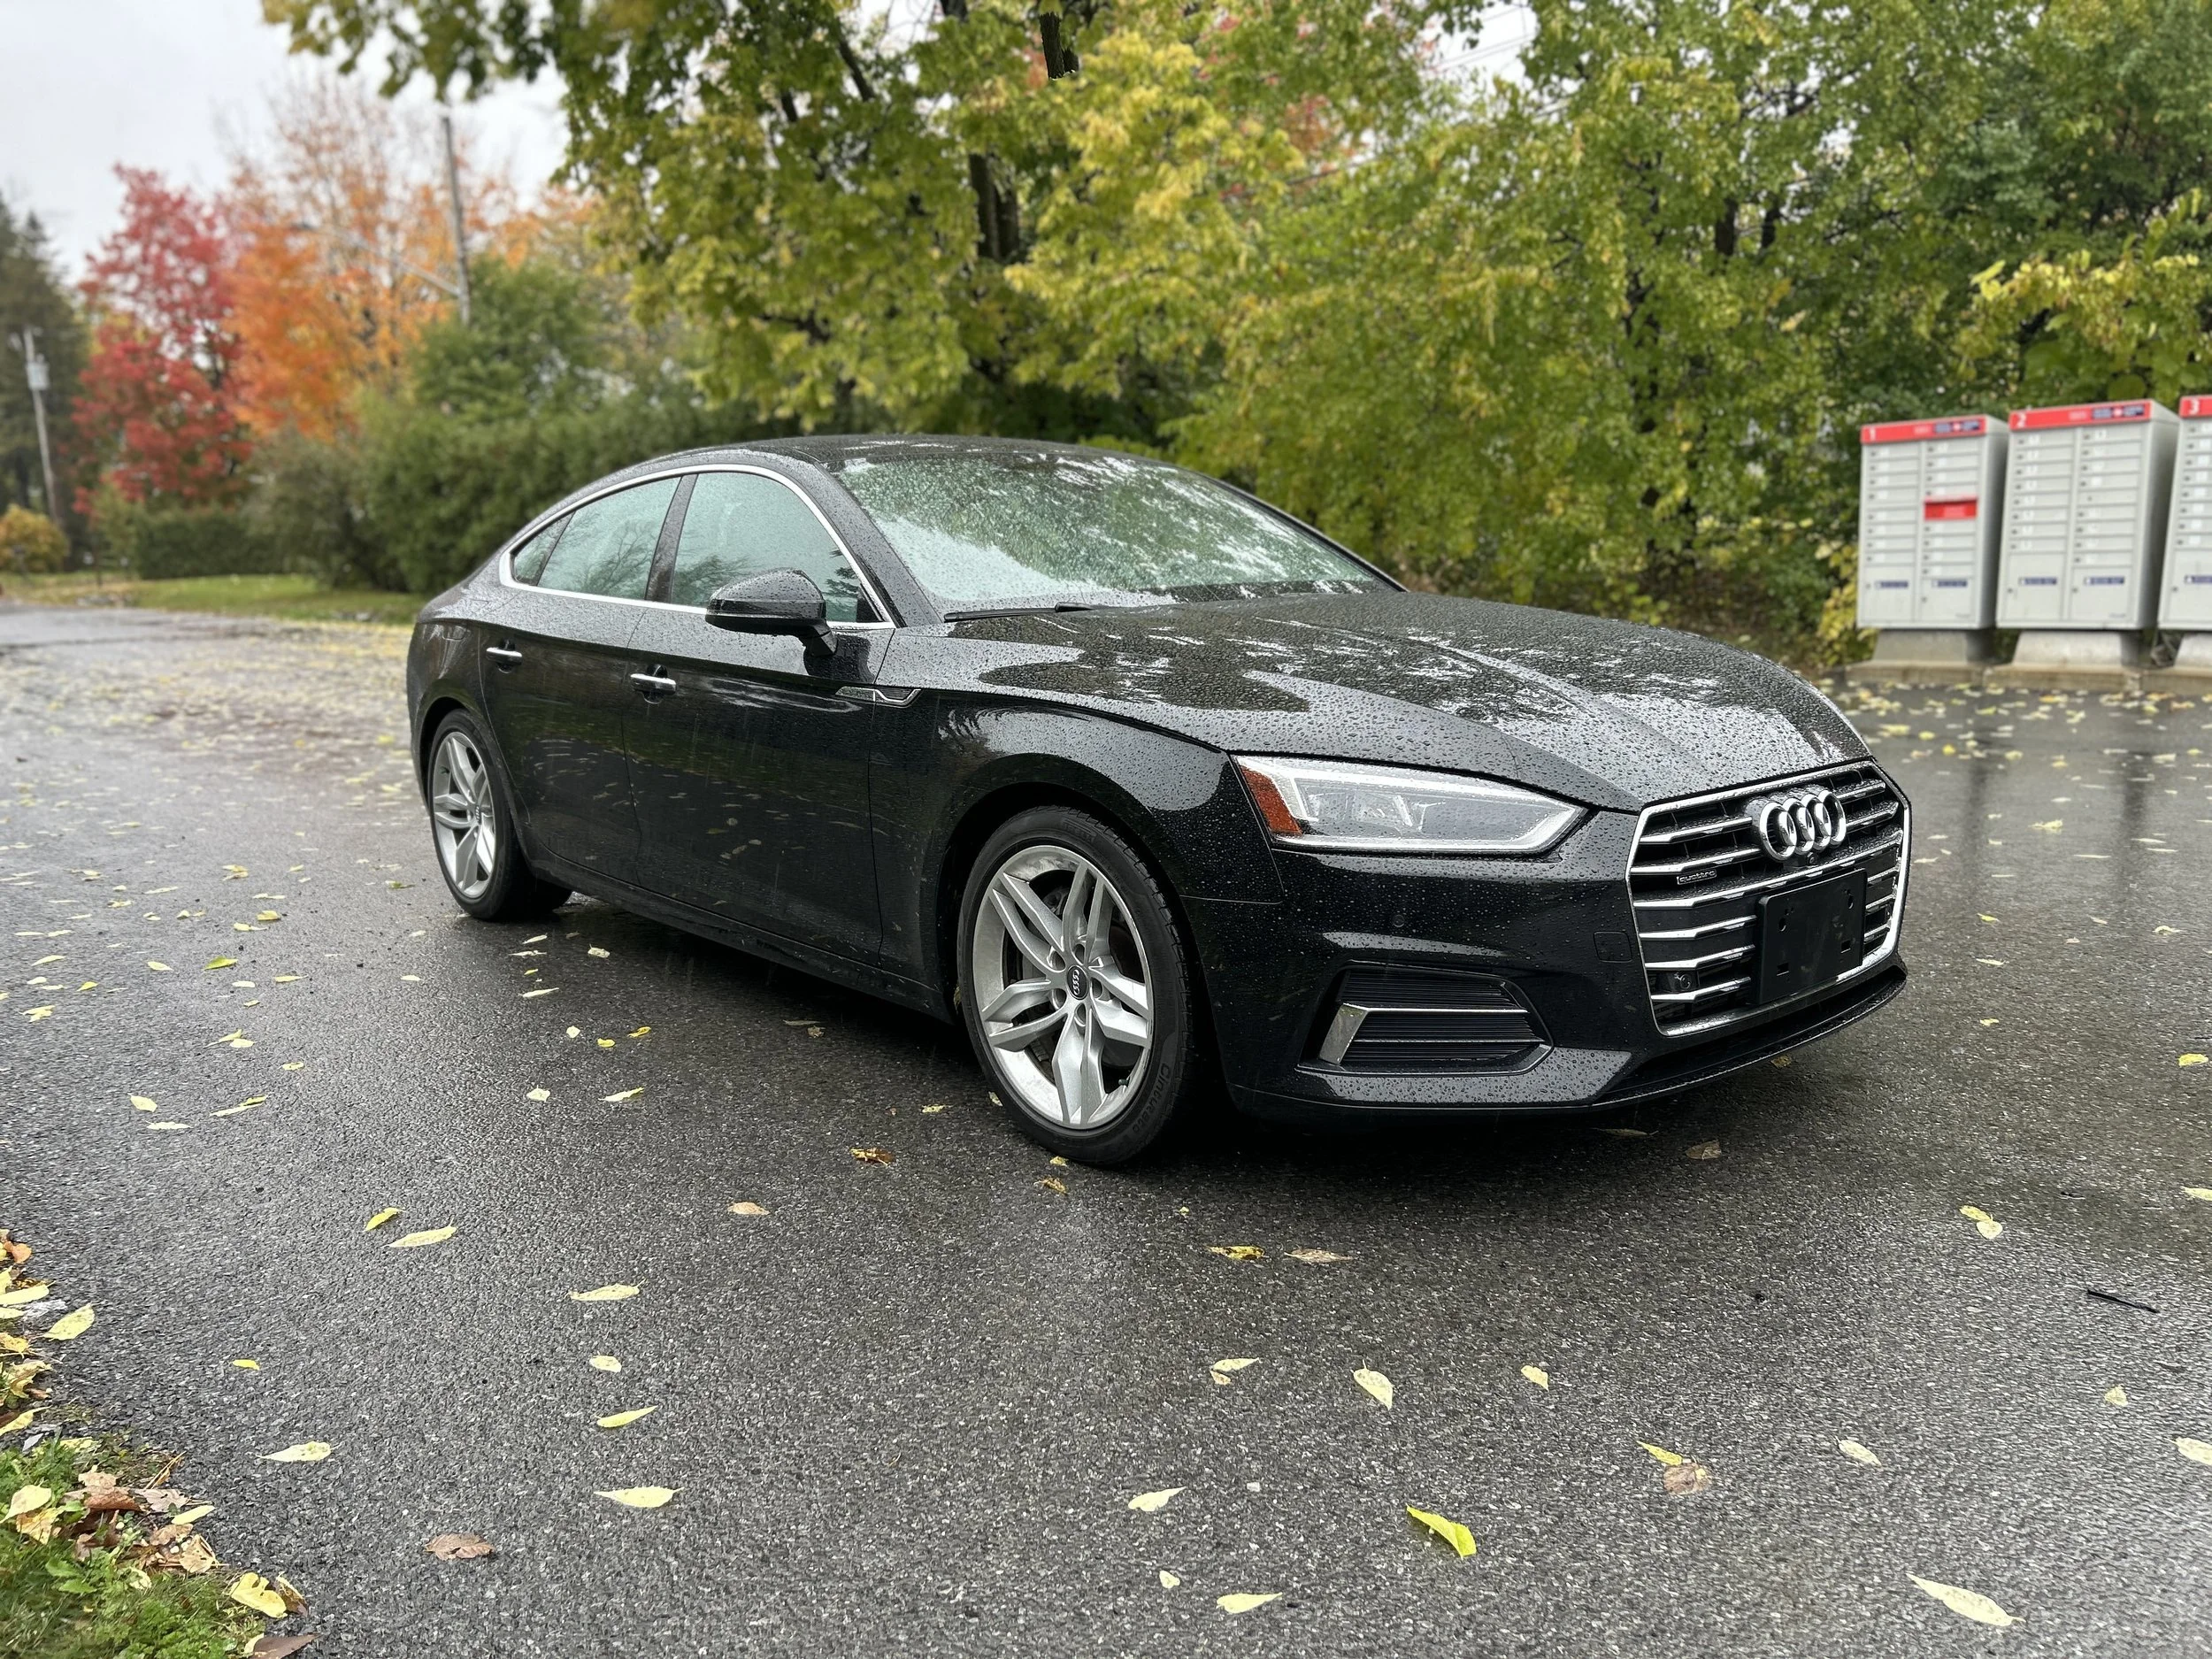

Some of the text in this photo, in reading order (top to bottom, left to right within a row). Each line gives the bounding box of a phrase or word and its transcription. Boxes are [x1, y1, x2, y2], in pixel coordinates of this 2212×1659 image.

[2189, 398, 2200, 415] 3
[2016, 412, 2026, 428] 2
[1869, 426, 1877, 442] 1
